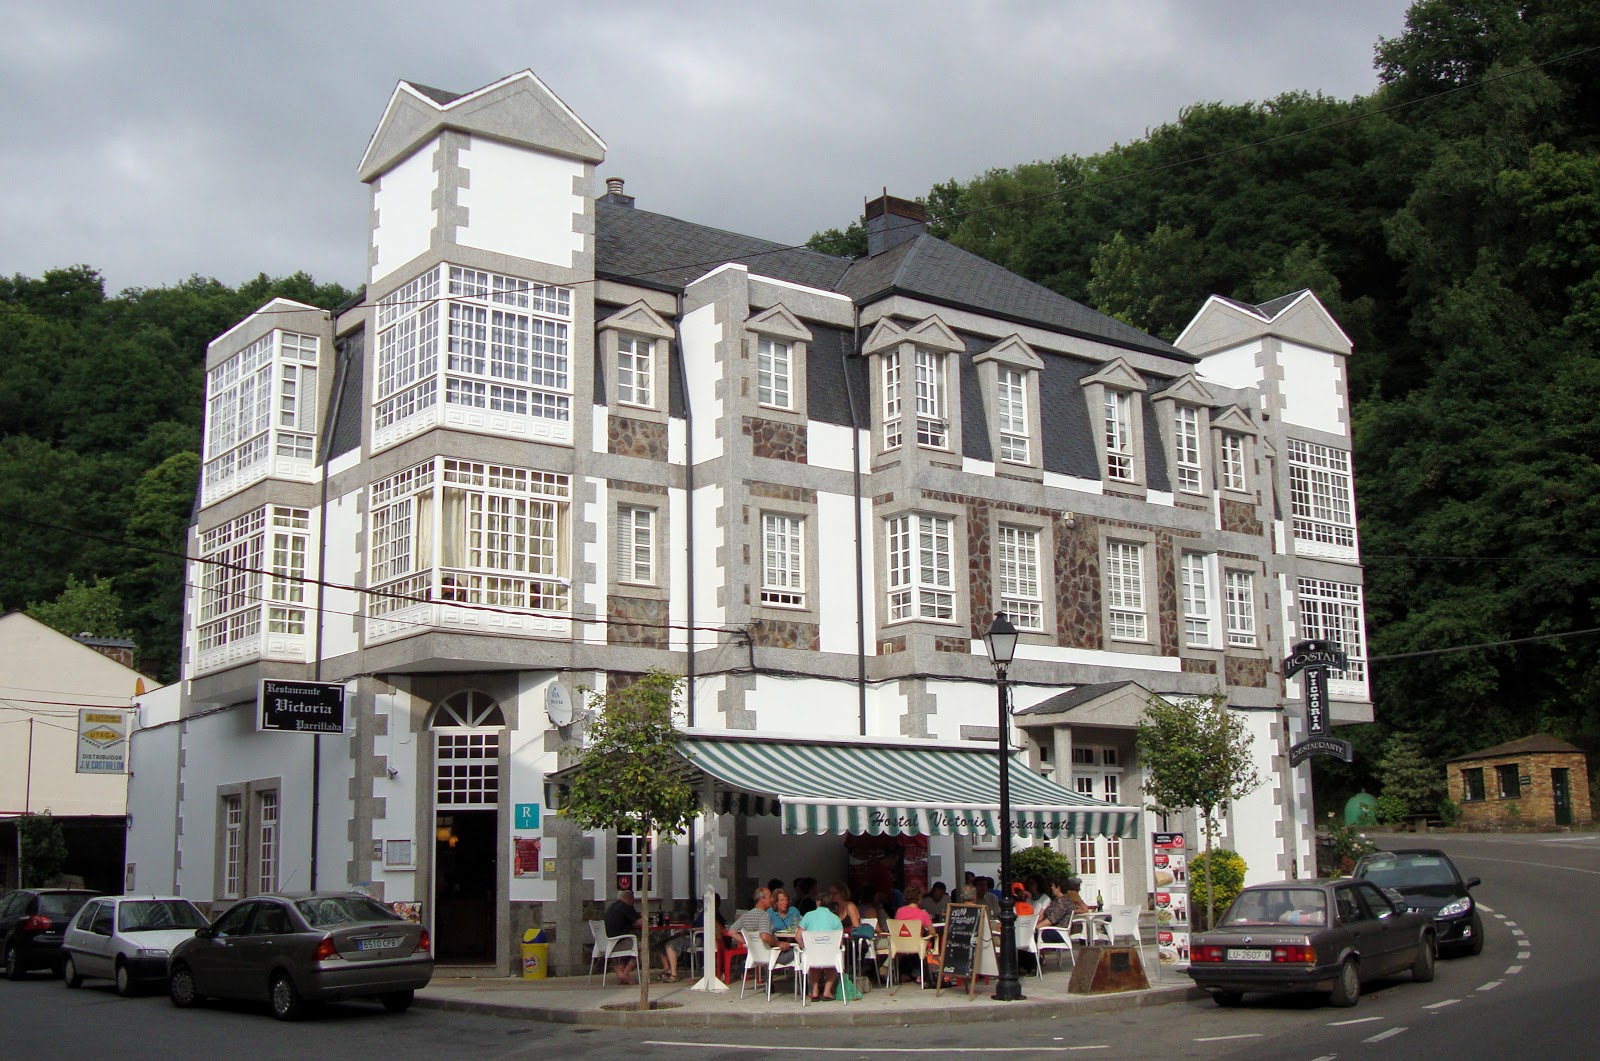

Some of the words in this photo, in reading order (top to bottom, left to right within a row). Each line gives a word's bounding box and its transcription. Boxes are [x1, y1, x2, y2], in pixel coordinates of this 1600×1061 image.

[1287, 651, 1338, 670] HOSTAL
[266, 683, 320, 695] Restaurante
[275, 698, 332, 714] Victoria
[1308, 671, 1320, 730] VICTORIA
[296, 719, 342, 731] Parrillada
[1292, 742, 1344, 759] RESTAURANTE
[522, 806, 531, 818] R
[868, 811, 919, 828] Hostal
[929, 811, 989, 828] Victoria
[998, 815, 1071, 831] estaurante
